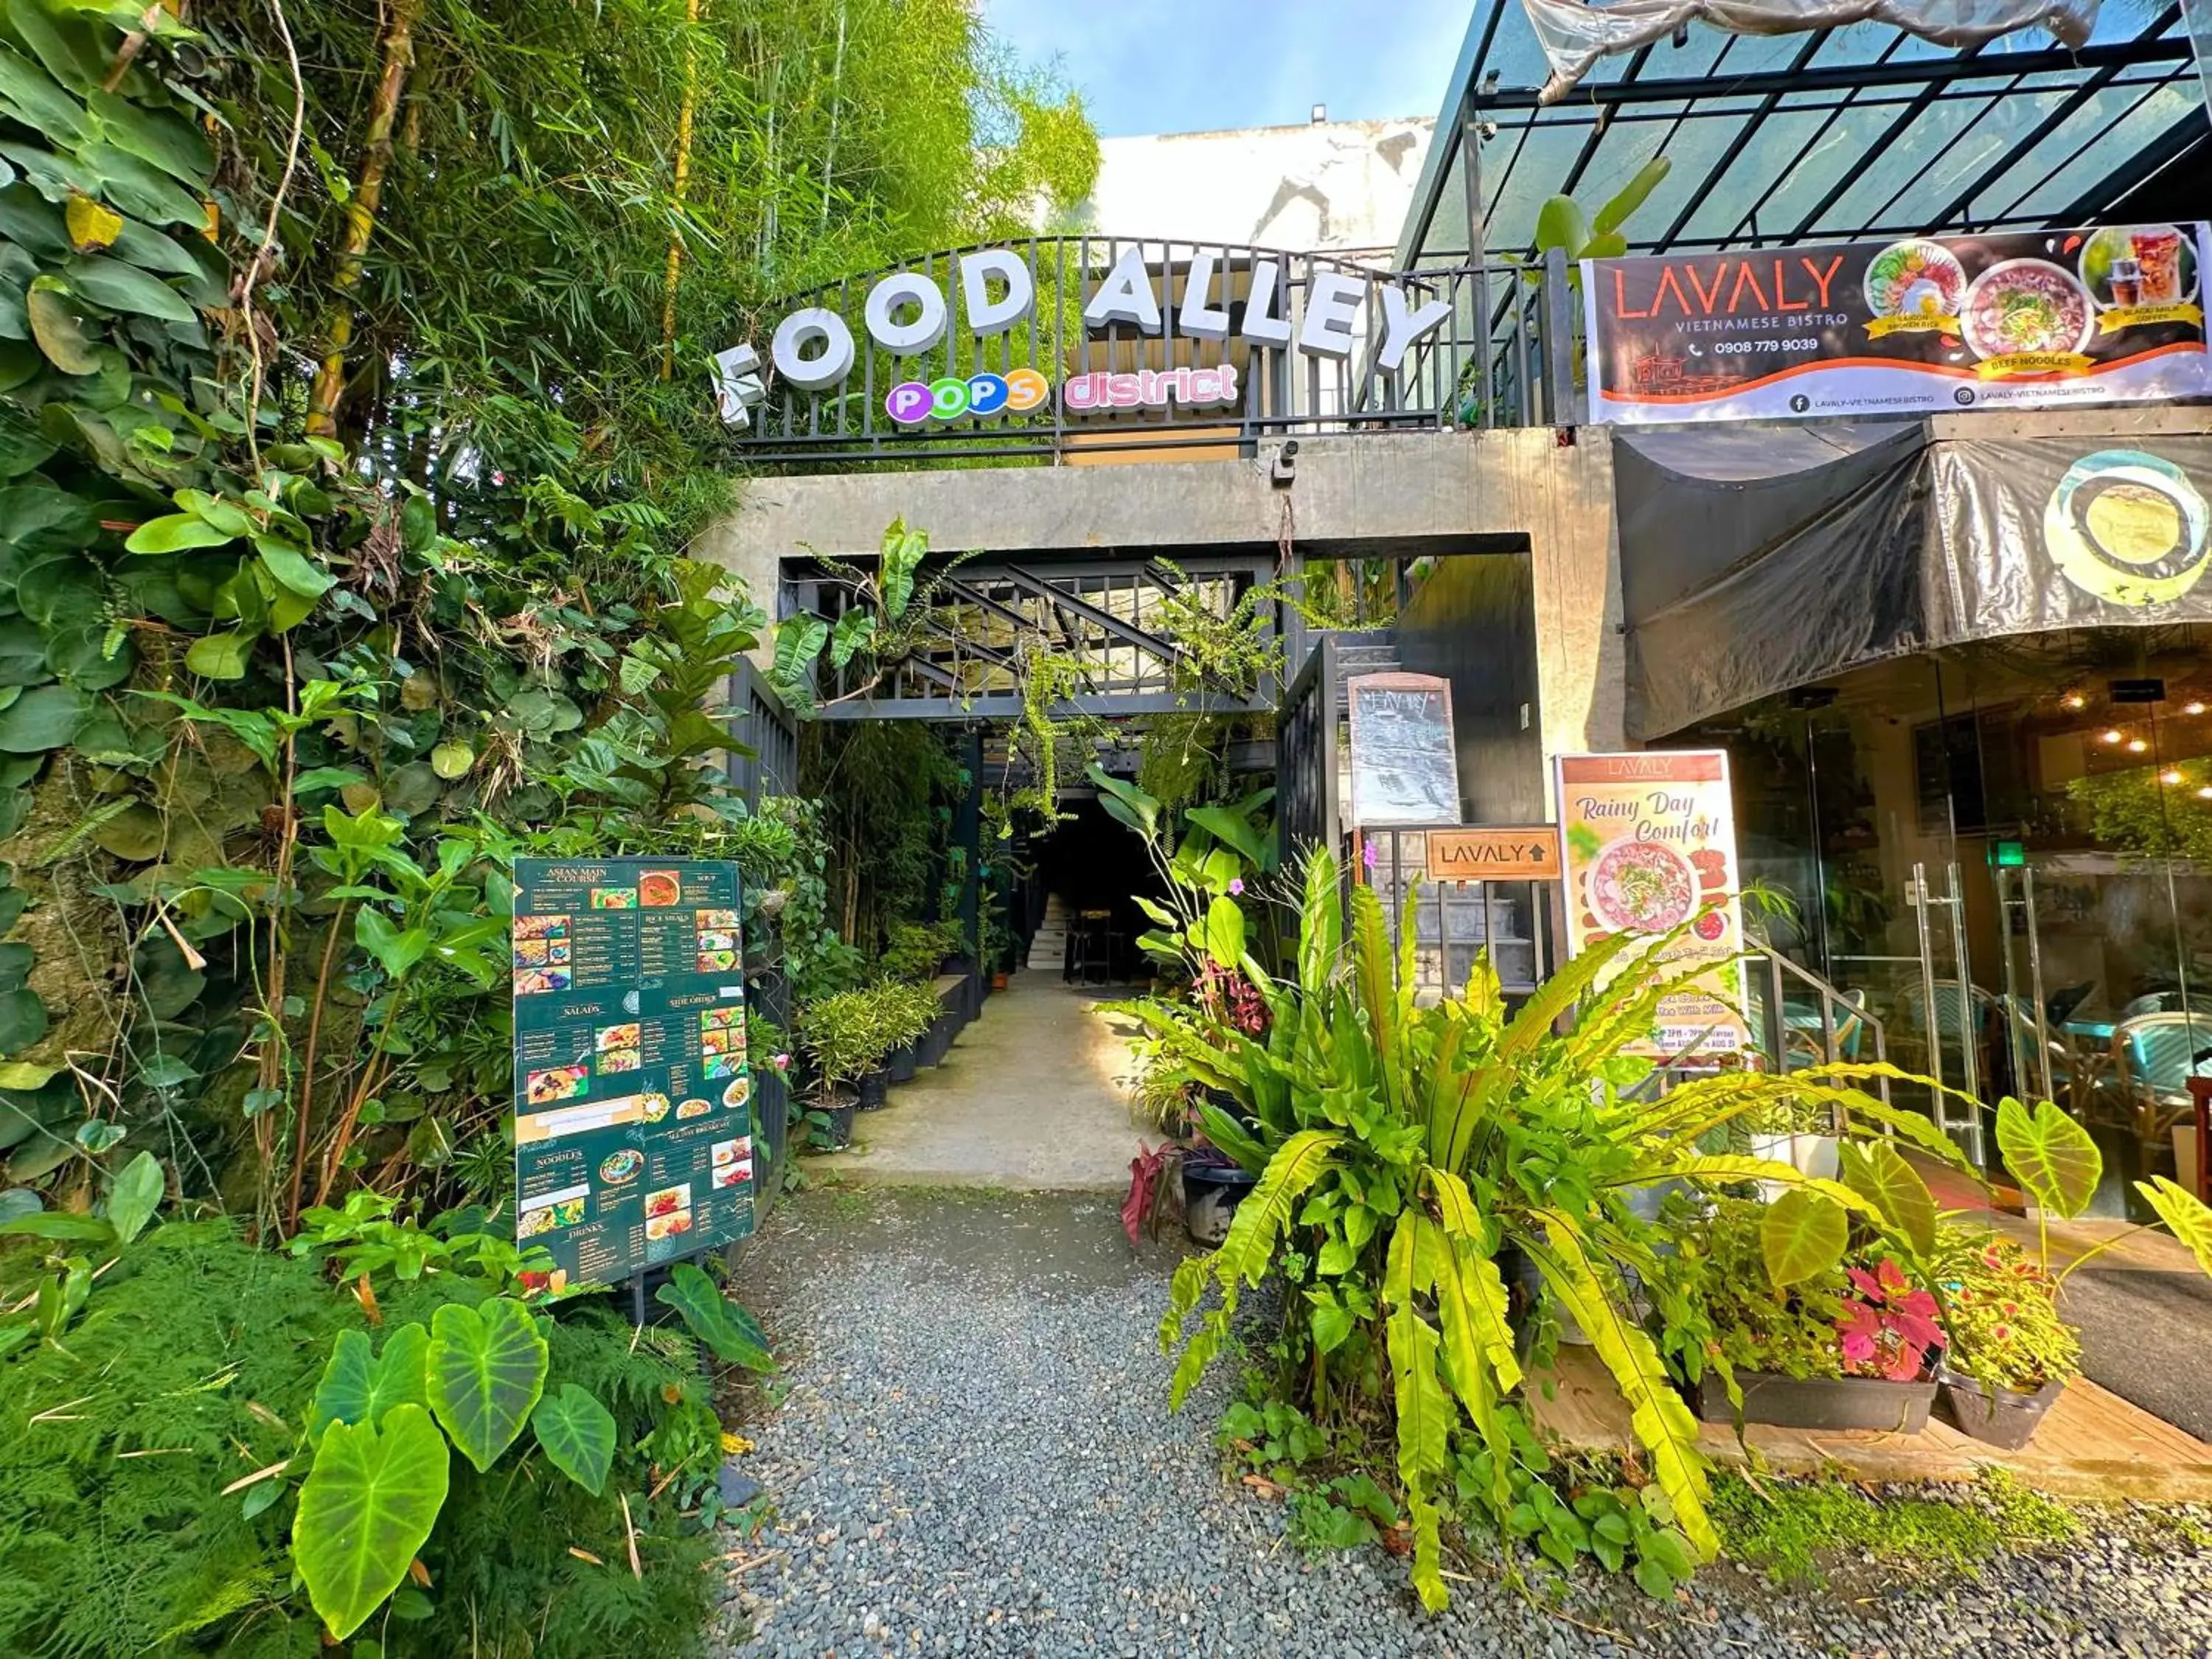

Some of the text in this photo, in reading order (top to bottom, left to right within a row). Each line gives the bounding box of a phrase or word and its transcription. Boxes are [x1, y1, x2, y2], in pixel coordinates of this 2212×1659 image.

[1615, 256, 1843, 319] LAVALY
[1675, 313, 1848, 333] VIETNAMESE BISTRO
[709, 246, 1453, 432] FOOD ALLEY
[1714, 338, 1818, 354] 0908 779 9039
[1992, 358, 2017, 370] BEEF
[892, 364, 1239, 417] POPS district
[1608, 757, 1672, 774] LAVALY
[1576, 791, 1694, 821] Rainy Day
[1635, 817, 1719, 844] Comfort
[1441, 844, 1525, 864] LAVALY
[564, 1005, 599, 1015] SALADS
